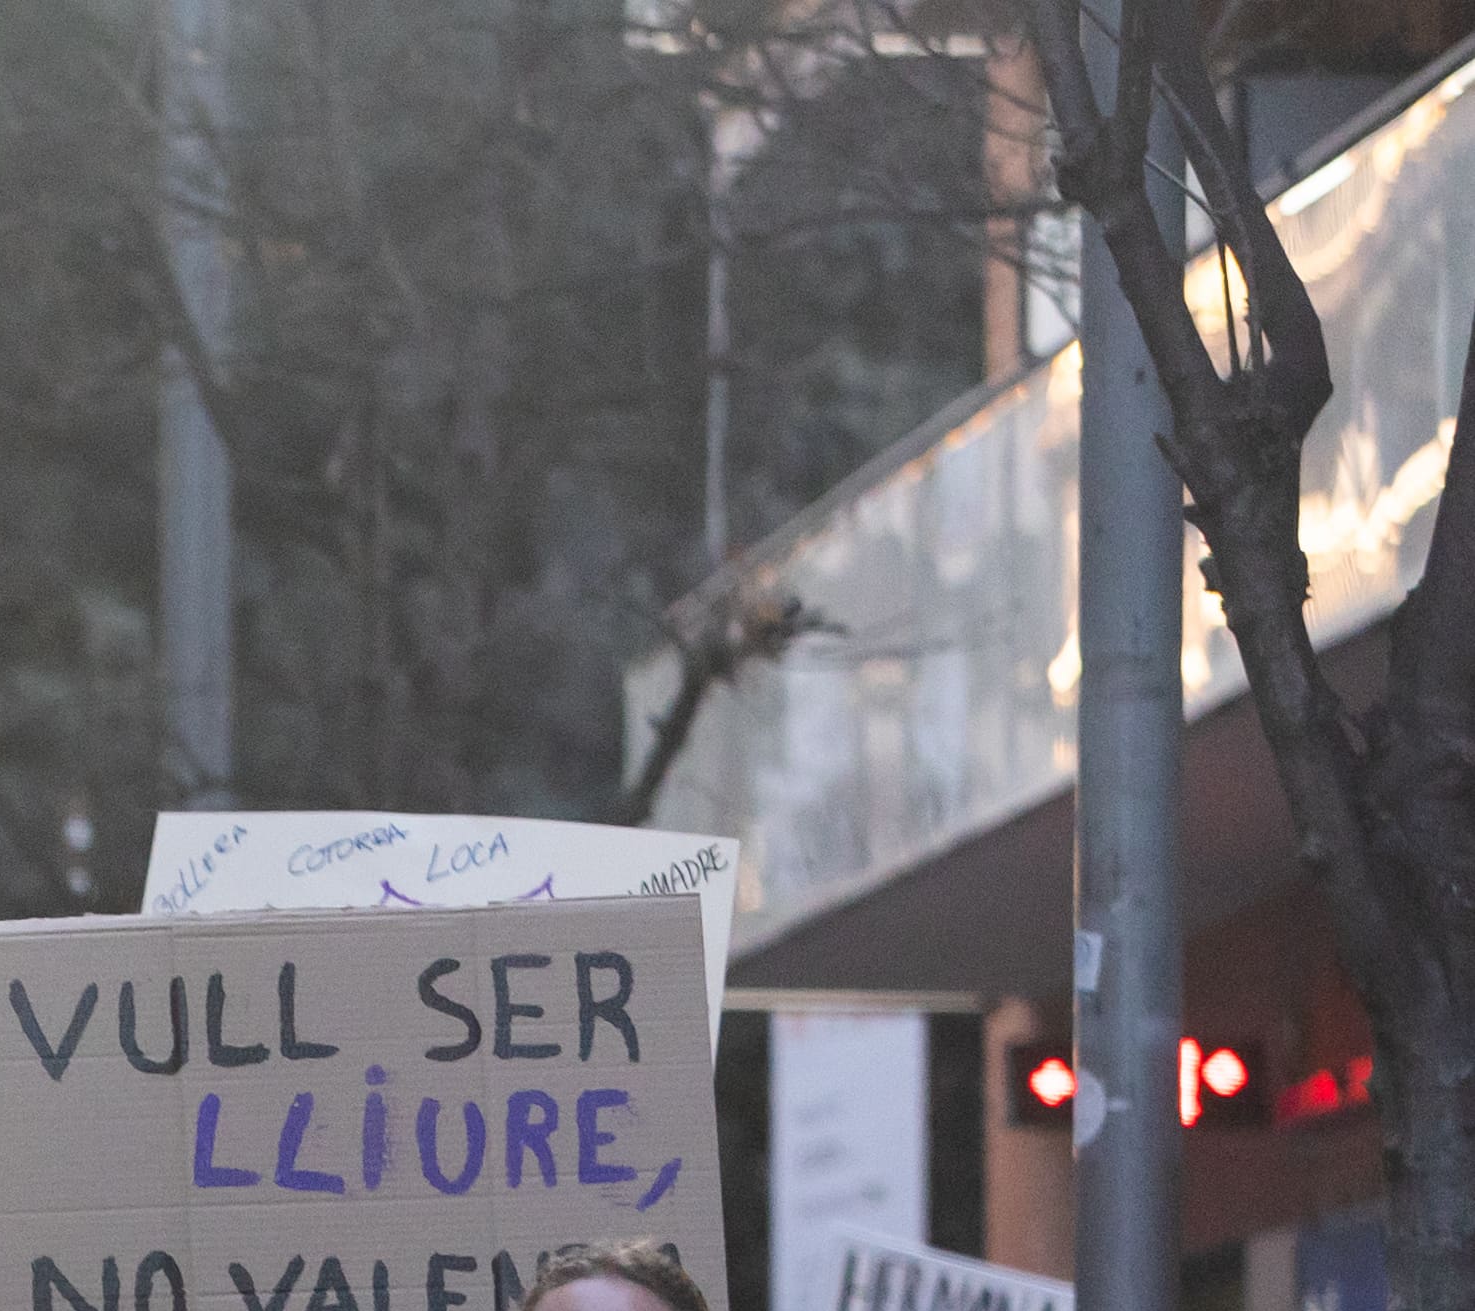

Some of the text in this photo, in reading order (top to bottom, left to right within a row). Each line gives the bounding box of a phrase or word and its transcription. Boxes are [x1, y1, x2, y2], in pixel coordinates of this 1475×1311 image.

[425, 832, 510, 882] LOCA
[8, 951, 640, 1083] VULL SER
